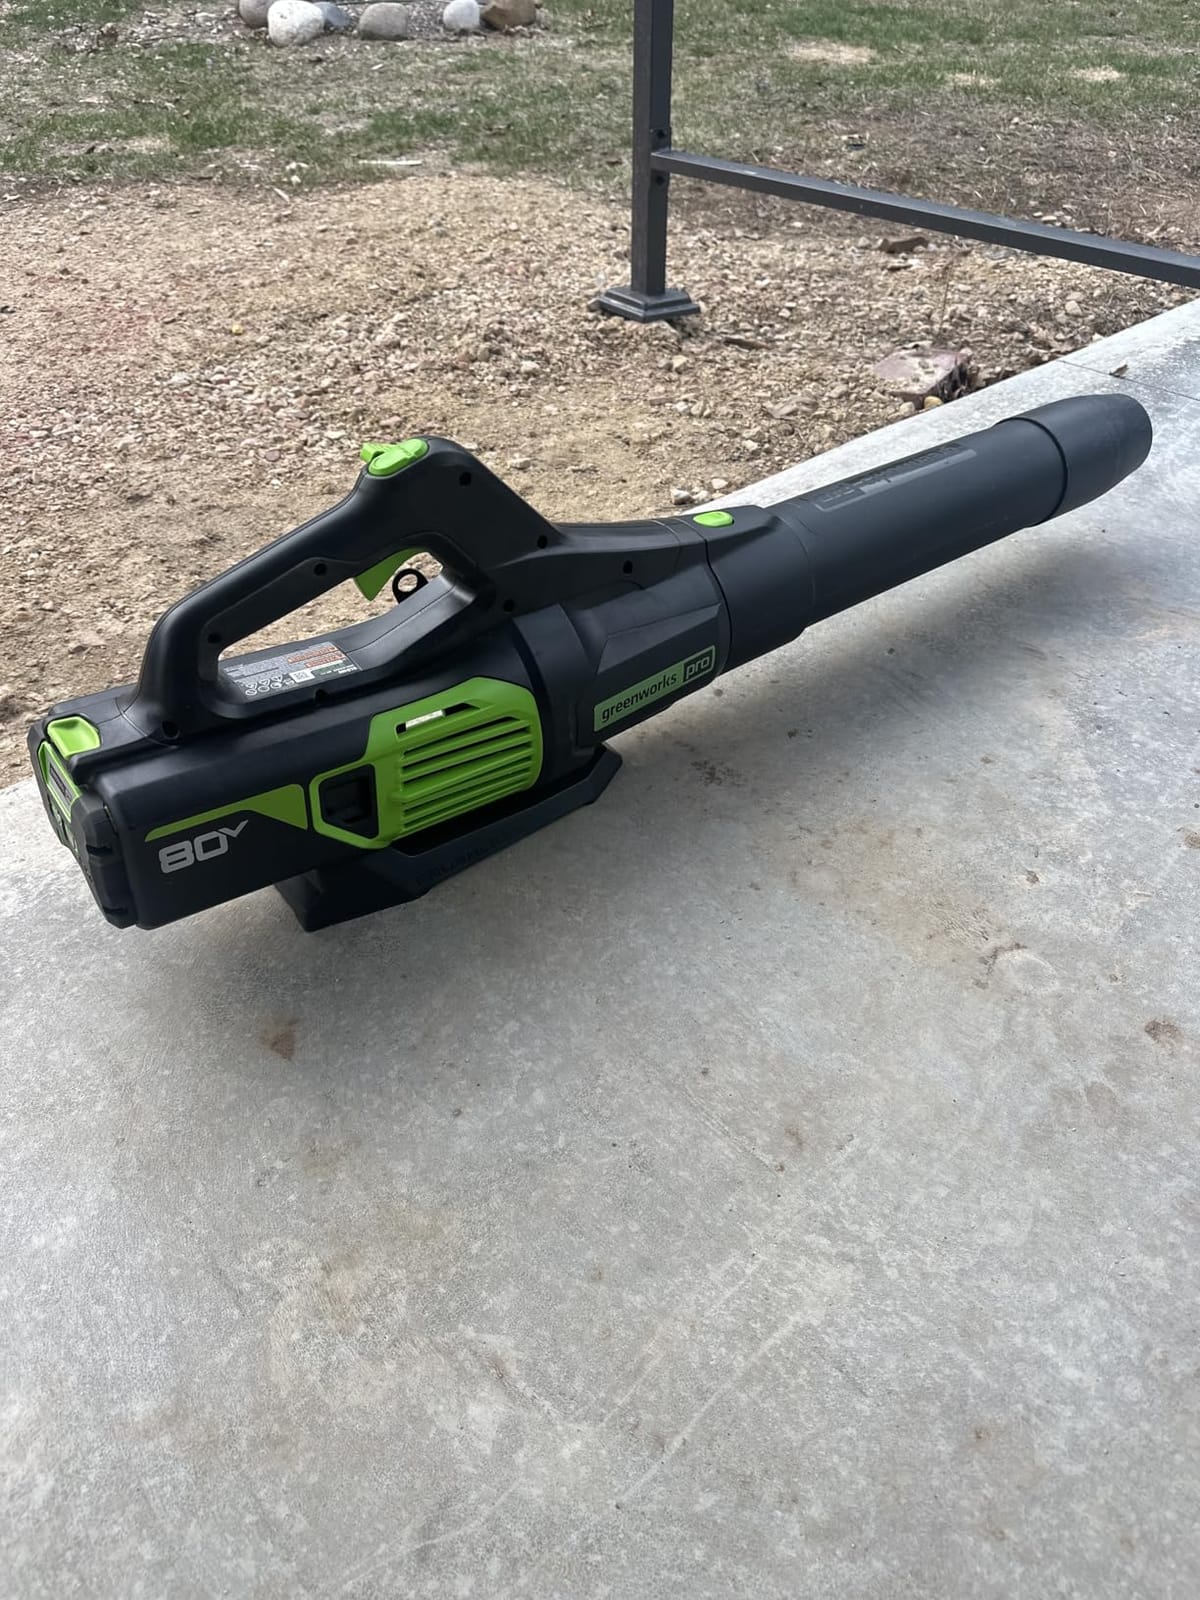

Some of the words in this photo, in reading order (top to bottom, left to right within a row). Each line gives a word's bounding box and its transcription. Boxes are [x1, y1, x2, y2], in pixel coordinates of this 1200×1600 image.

[602, 675, 677, 722] greenworks
[685, 656, 710, 680] pro
[158, 819, 248, 874] 80V
